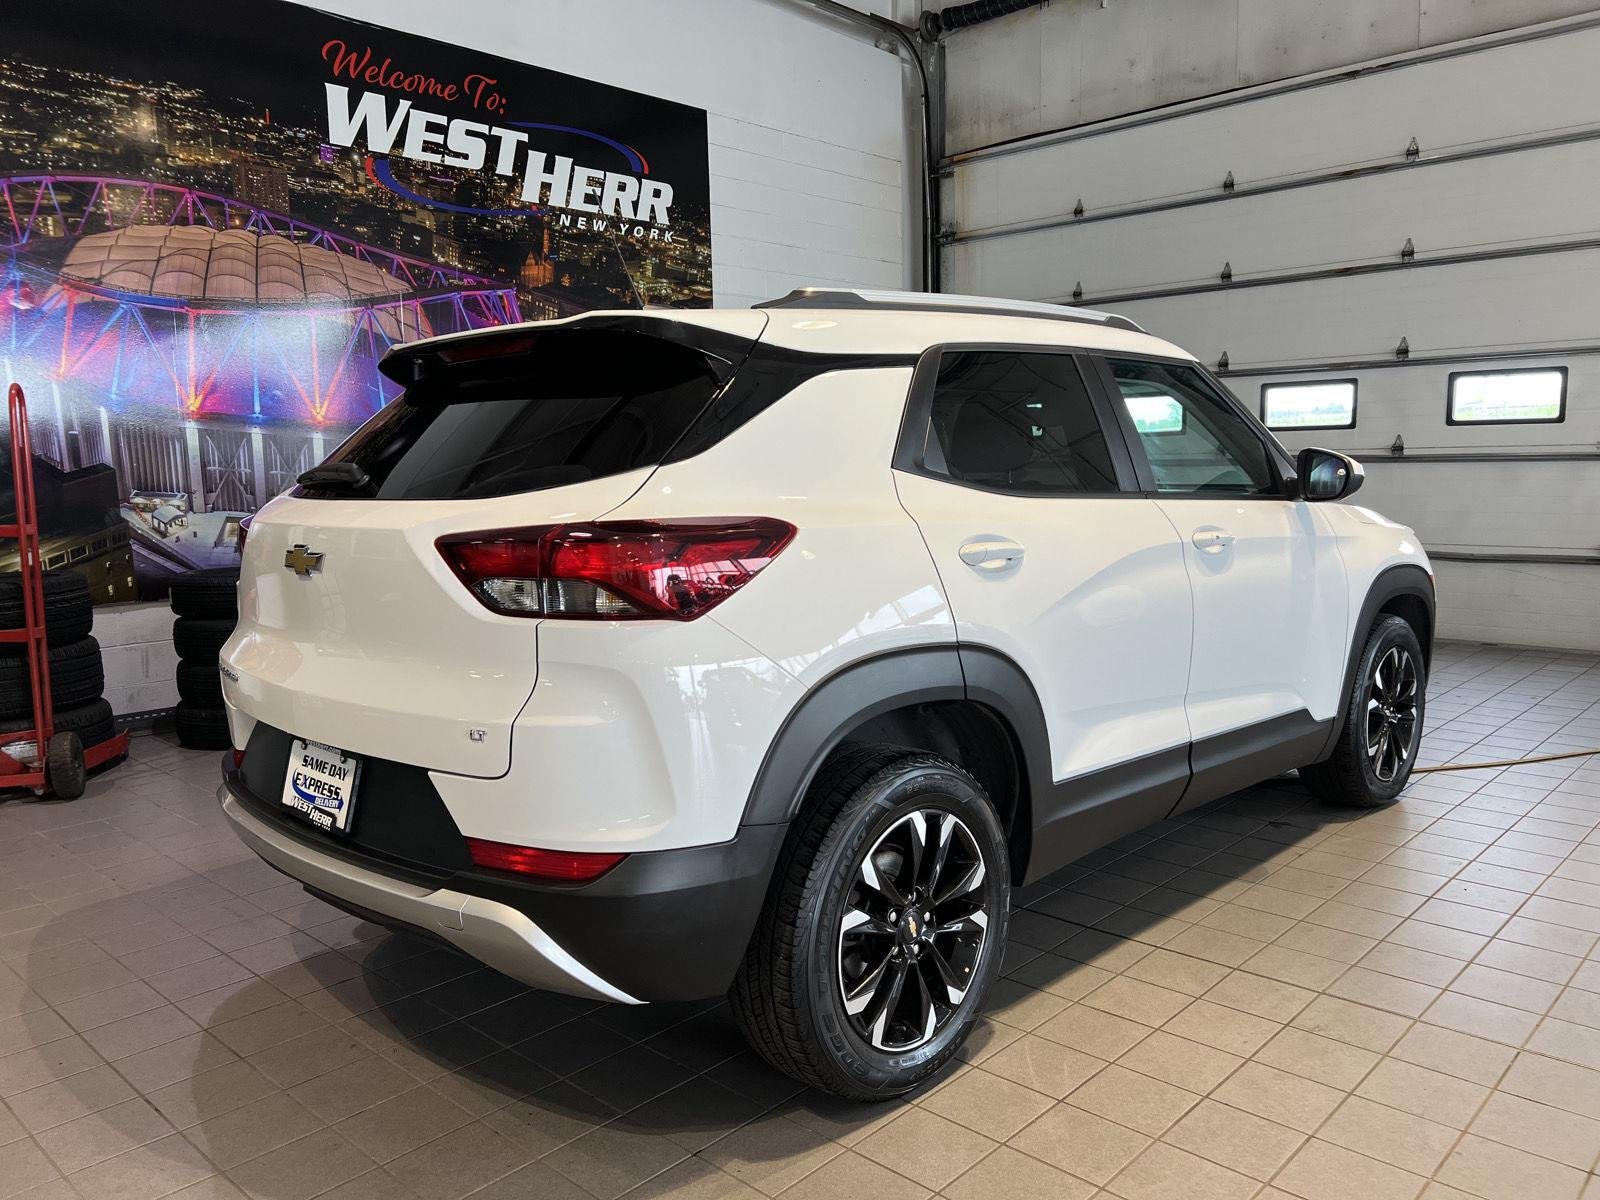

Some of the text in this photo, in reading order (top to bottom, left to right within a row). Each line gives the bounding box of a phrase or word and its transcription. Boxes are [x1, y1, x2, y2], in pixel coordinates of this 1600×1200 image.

[321, 39, 507, 115] Welcome To:
[324, 82, 674, 225] WEST HERR
[560, 213, 675, 243] NEW YORK
[469, 729, 487, 743] LT
[301, 754, 349, 781] SAME DAY
[294, 771, 342, 800] EXPRESS
[291, 796, 314, 814] WEST
[309, 808, 333, 827] HERR
[314, 796, 339, 808] DELIVERY
